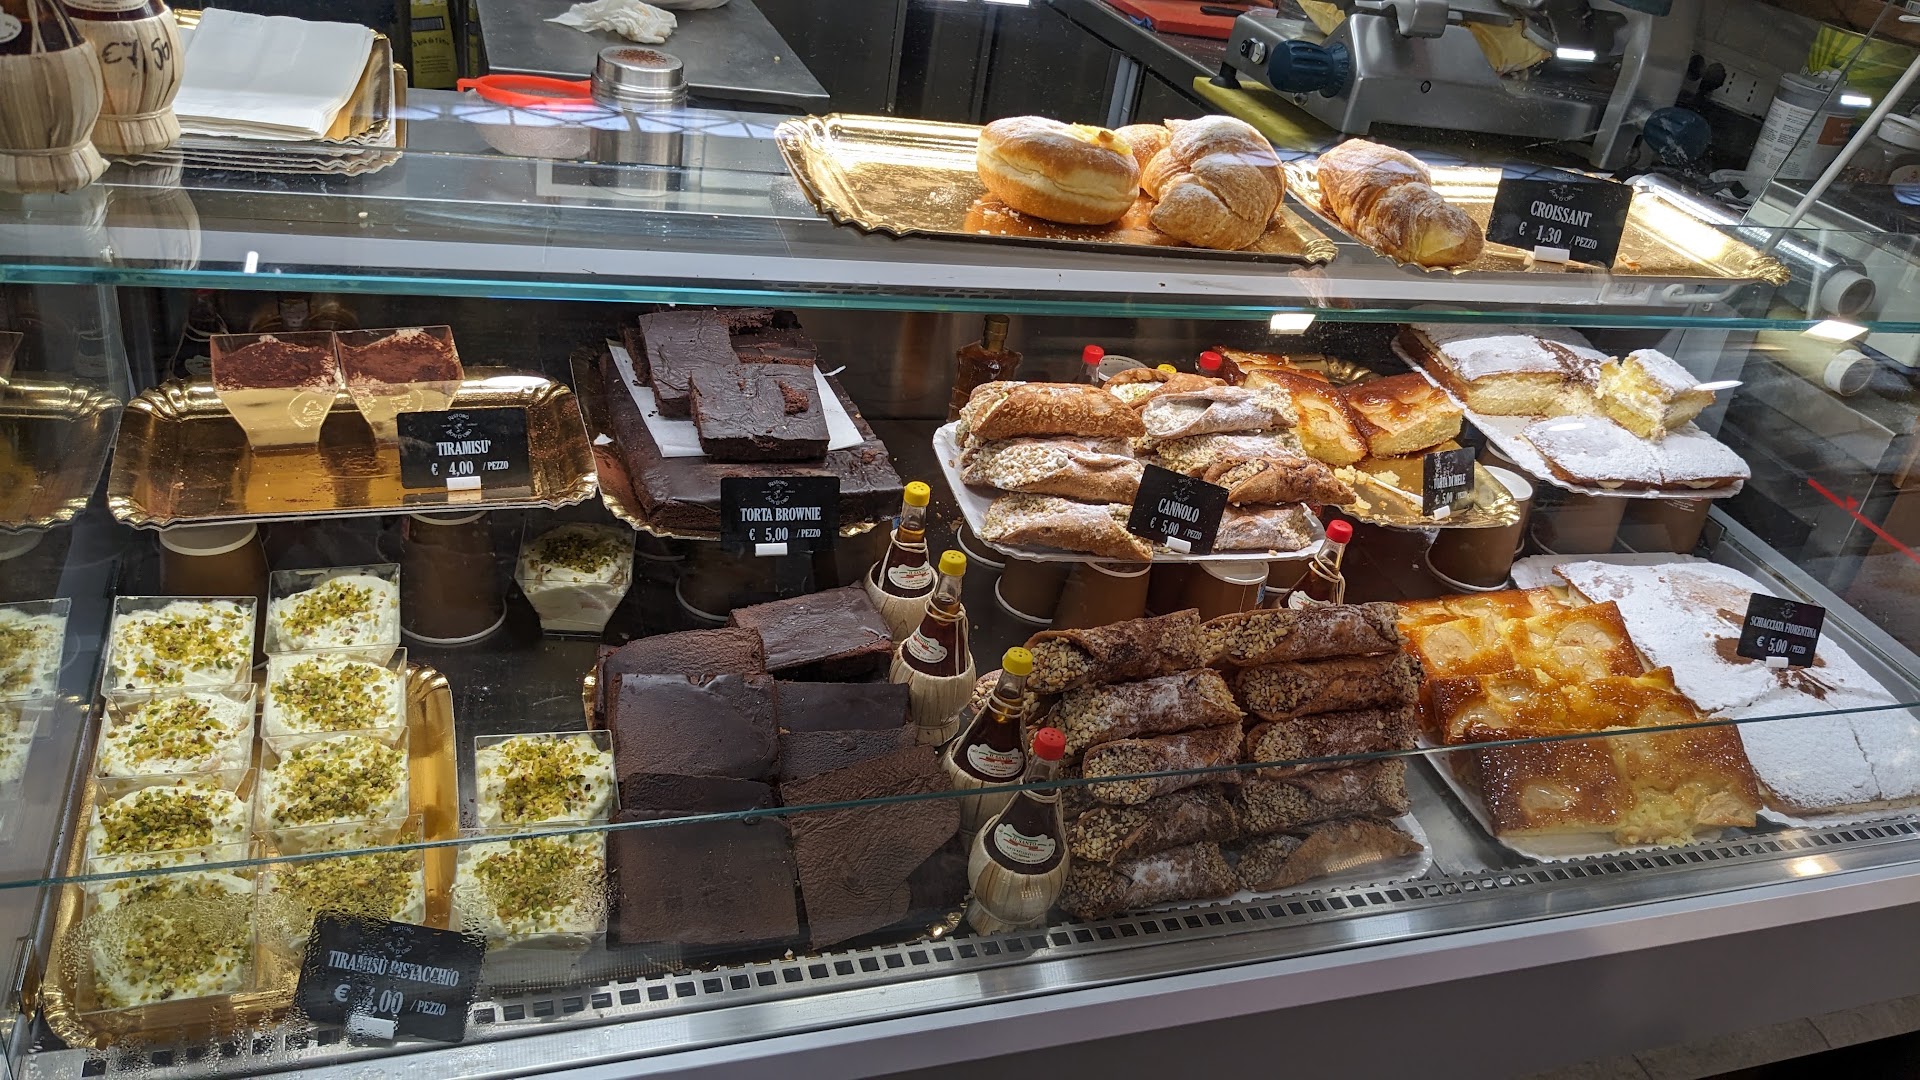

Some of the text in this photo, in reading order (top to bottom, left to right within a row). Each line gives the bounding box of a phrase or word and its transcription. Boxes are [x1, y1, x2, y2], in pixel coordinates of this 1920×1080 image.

[1530, 200, 1593, 228] CROISSANT
[1518, 221, 1527, 236] €
[1535, 225, 1562, 244] 1,30
[431, 463, 438, 476] €
[449, 460, 474, 477] 4,00
[740, 506, 821, 521] TORTA BROWNIE
[1158, 498, 1200, 523] CANNOLO
[749, 528, 756, 541] €
[765, 527, 789, 543] 5,00
[1149, 516, 1157, 528] €
[1160, 519, 1180, 536] 5,00
[1749, 615, 1817, 639] SCHIACCIATA FIORENTINA
[1756, 635, 1765, 647] €
[1767, 637, 1788, 654] 5,00
[333, 983, 351, 1002] €
